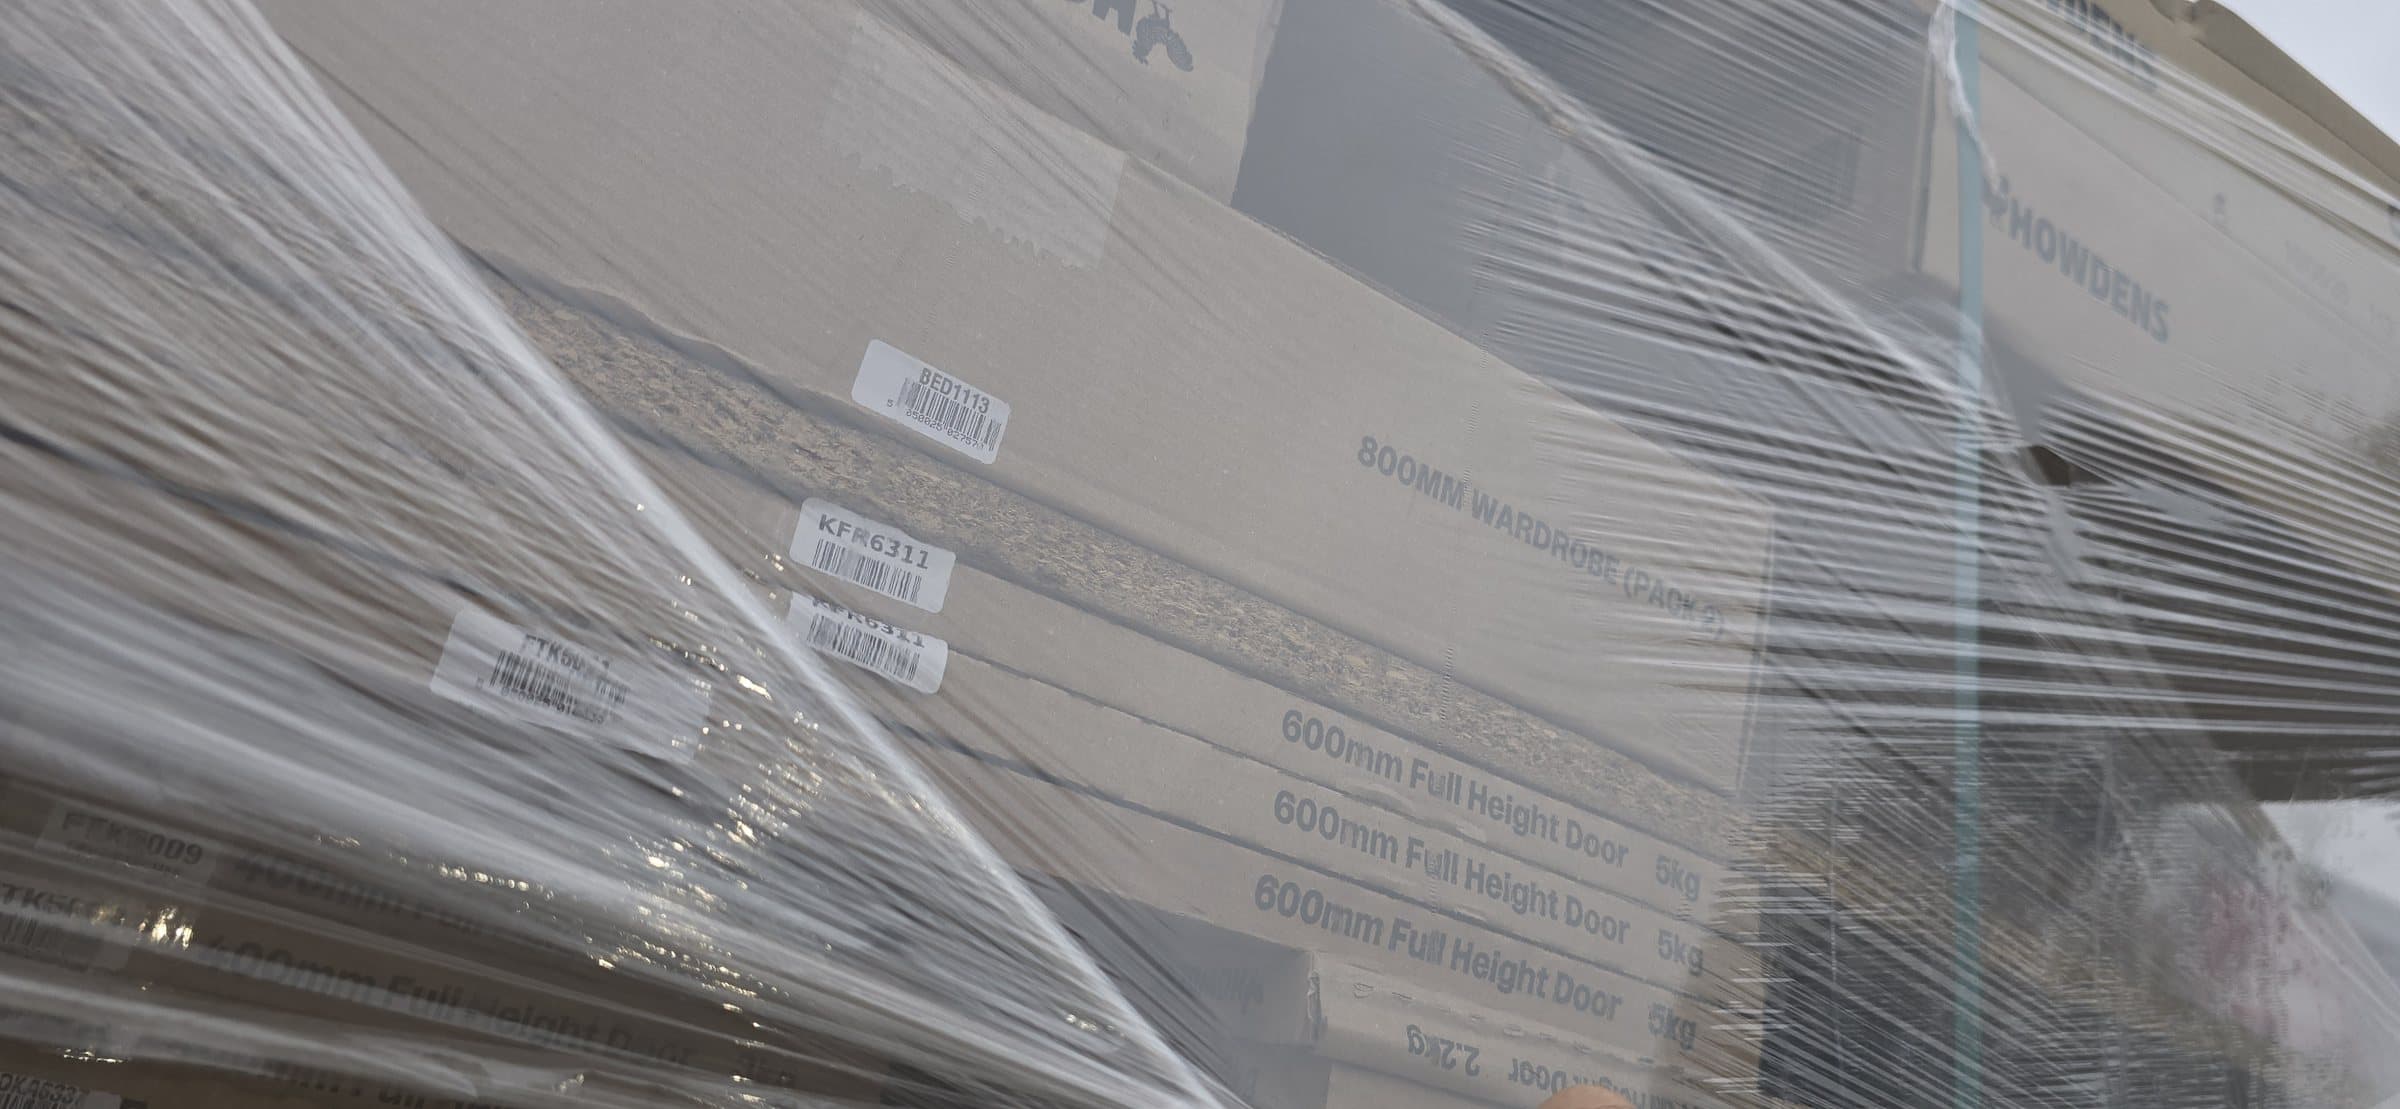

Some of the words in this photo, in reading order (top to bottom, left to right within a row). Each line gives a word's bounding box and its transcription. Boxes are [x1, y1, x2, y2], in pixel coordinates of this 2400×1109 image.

[2008, 196, 2169, 344] HOWDENS
[919, 367, 990, 414] BED1113
[818, 513, 930, 570] KFR6311
[1357, 435, 1465, 512] 800MM
[1470, 491, 1621, 585] WARDROBE
[1282, 709, 1402, 783] 600mm
[1409, 758, 1461, 805] Full
[1468, 780, 1559, 842] Height
[1565, 818, 1630, 868] Door
[1655, 855, 1700, 902] 5kg
[1273, 789, 1399, 864] 600mm
[1405, 837, 1458, 885] Full
[1465, 860, 1559, 921] Height
[1565, 898, 1631, 945] Door
[1657, 928, 1703, 976] 5kg
[1254, 874, 1384, 946] 600mm
[1388, 918, 1444, 966] Full
[1450, 937, 1549, 1000] Height
[1553, 971, 1624, 1022] Door
[1648, 1003, 1697, 1050] 5kg
[1406, 1024, 1481, 1077] 2.2kg
